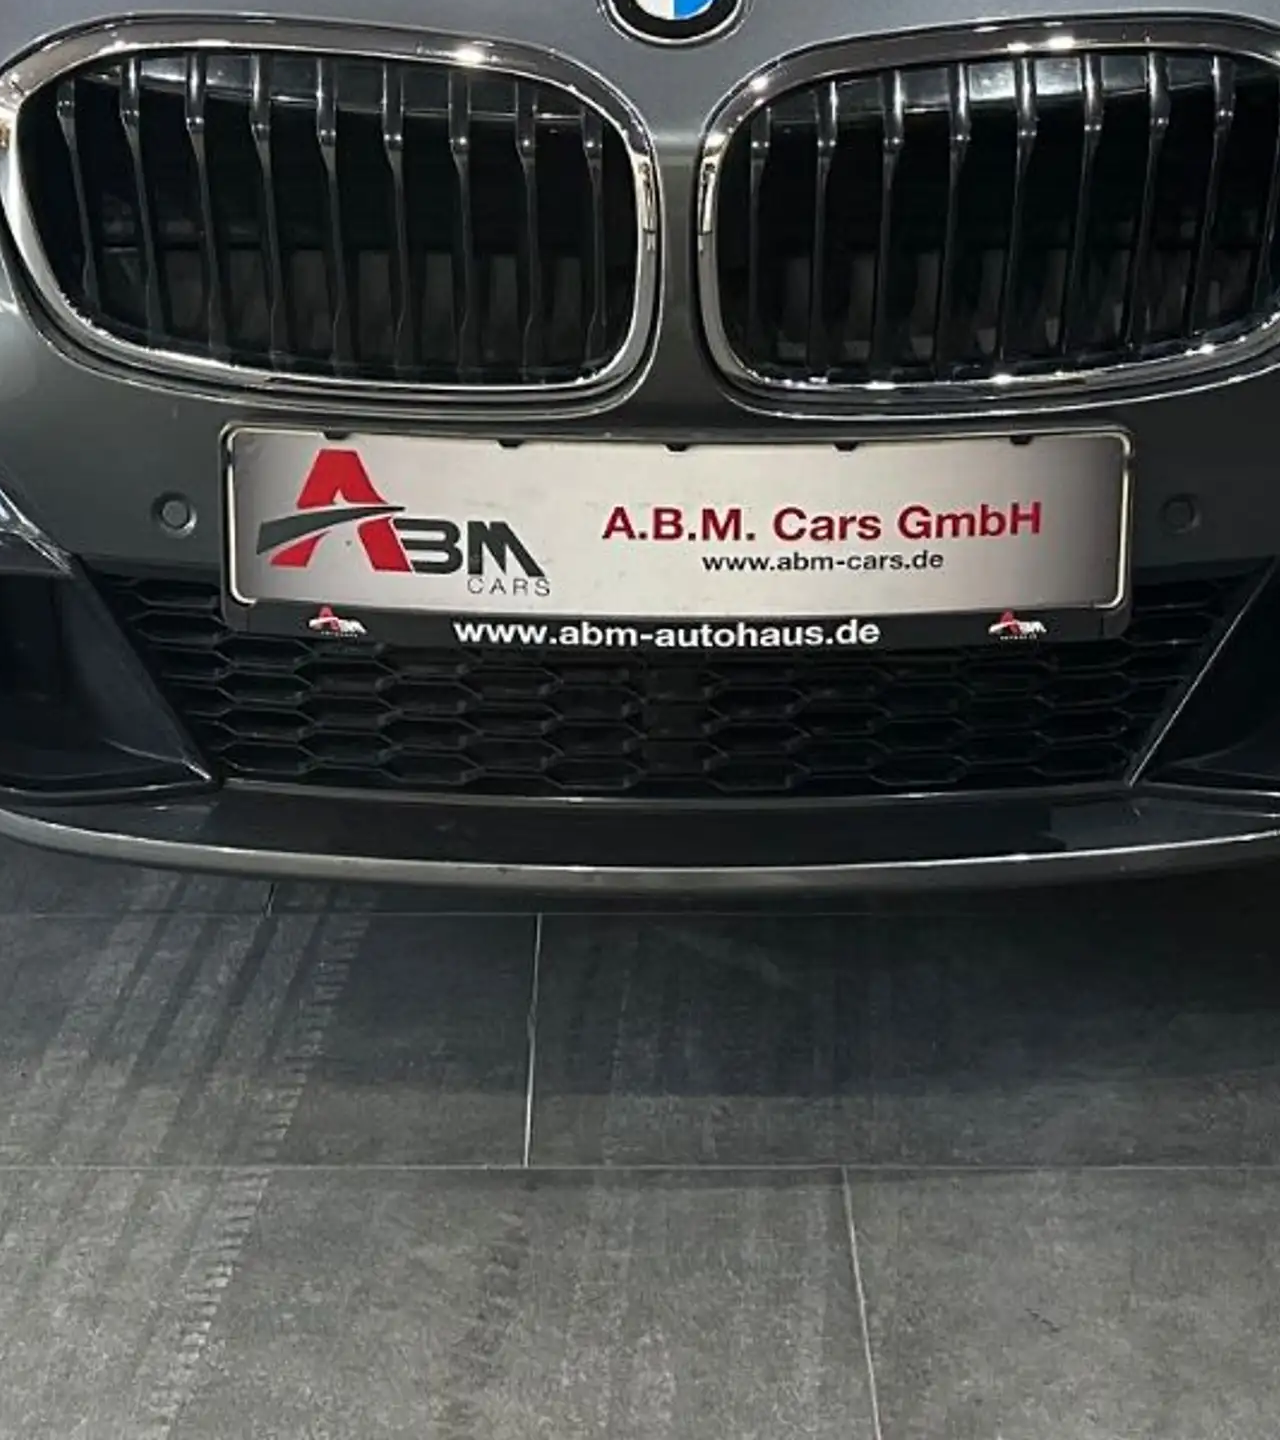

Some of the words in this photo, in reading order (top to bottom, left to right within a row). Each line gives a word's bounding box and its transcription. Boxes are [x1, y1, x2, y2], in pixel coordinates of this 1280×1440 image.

[256, 448, 547, 578] ABM
[602, 506, 756, 542] A.B.M.
[773, 507, 883, 541] Cars
[898, 501, 1043, 539] GmbH
[702, 549, 945, 572] www.abm-cars.de
[467, 577, 551, 597] CARS
[453, 620, 881, 648] www.abm-autohaus.de
